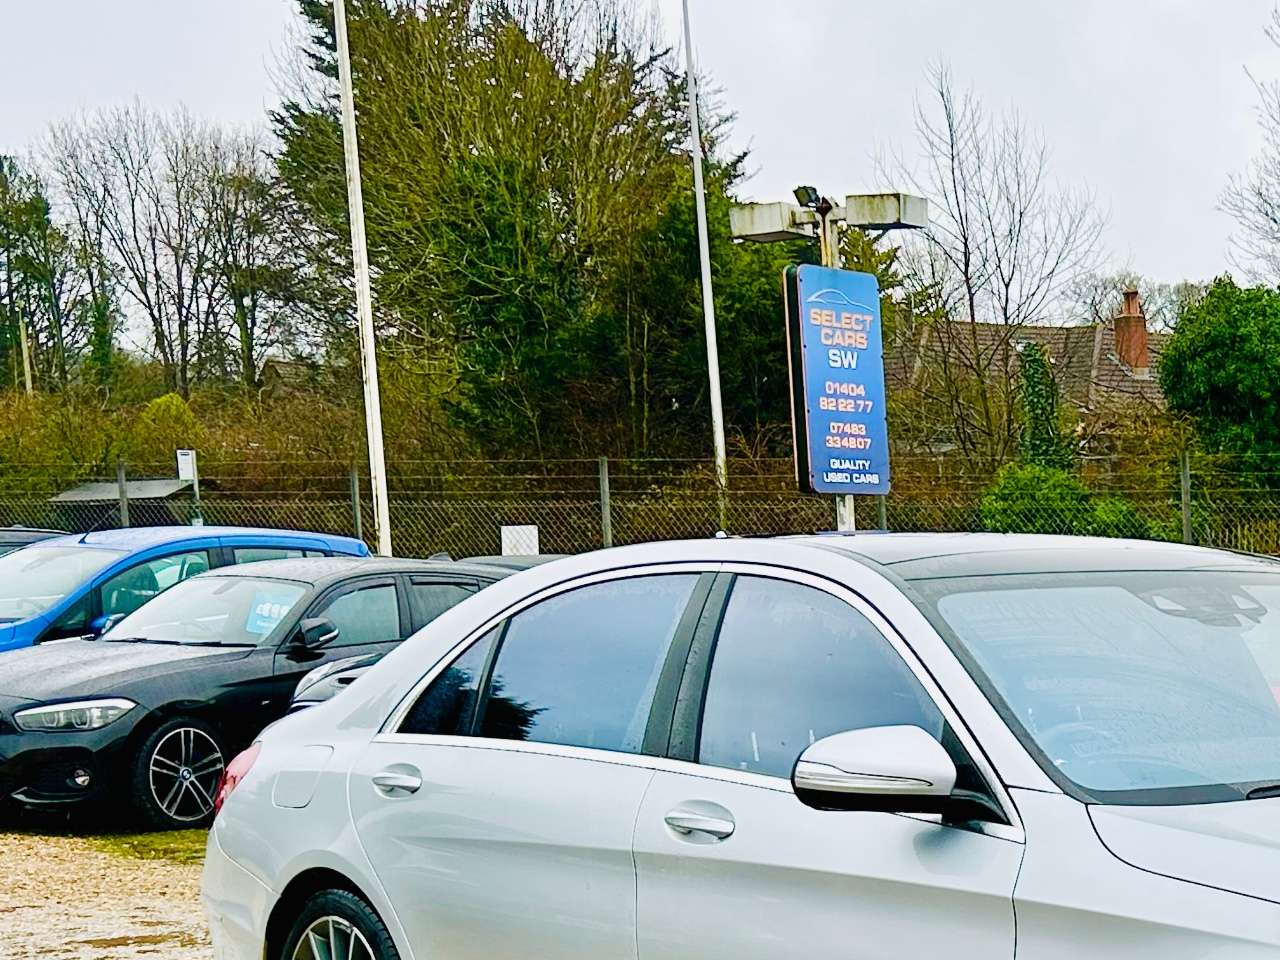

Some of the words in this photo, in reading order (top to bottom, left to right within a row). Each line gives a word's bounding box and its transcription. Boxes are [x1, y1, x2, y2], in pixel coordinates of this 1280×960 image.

[810, 308, 873, 332] SELECT
[821, 327, 868, 350] CARS
[828, 348, 858, 369] SW
[825, 381, 866, 397] 01404
[830, 458, 871, 471] QUALITY
[823, 471, 850, 484] USED
[852, 473, 880, 485] CARS
